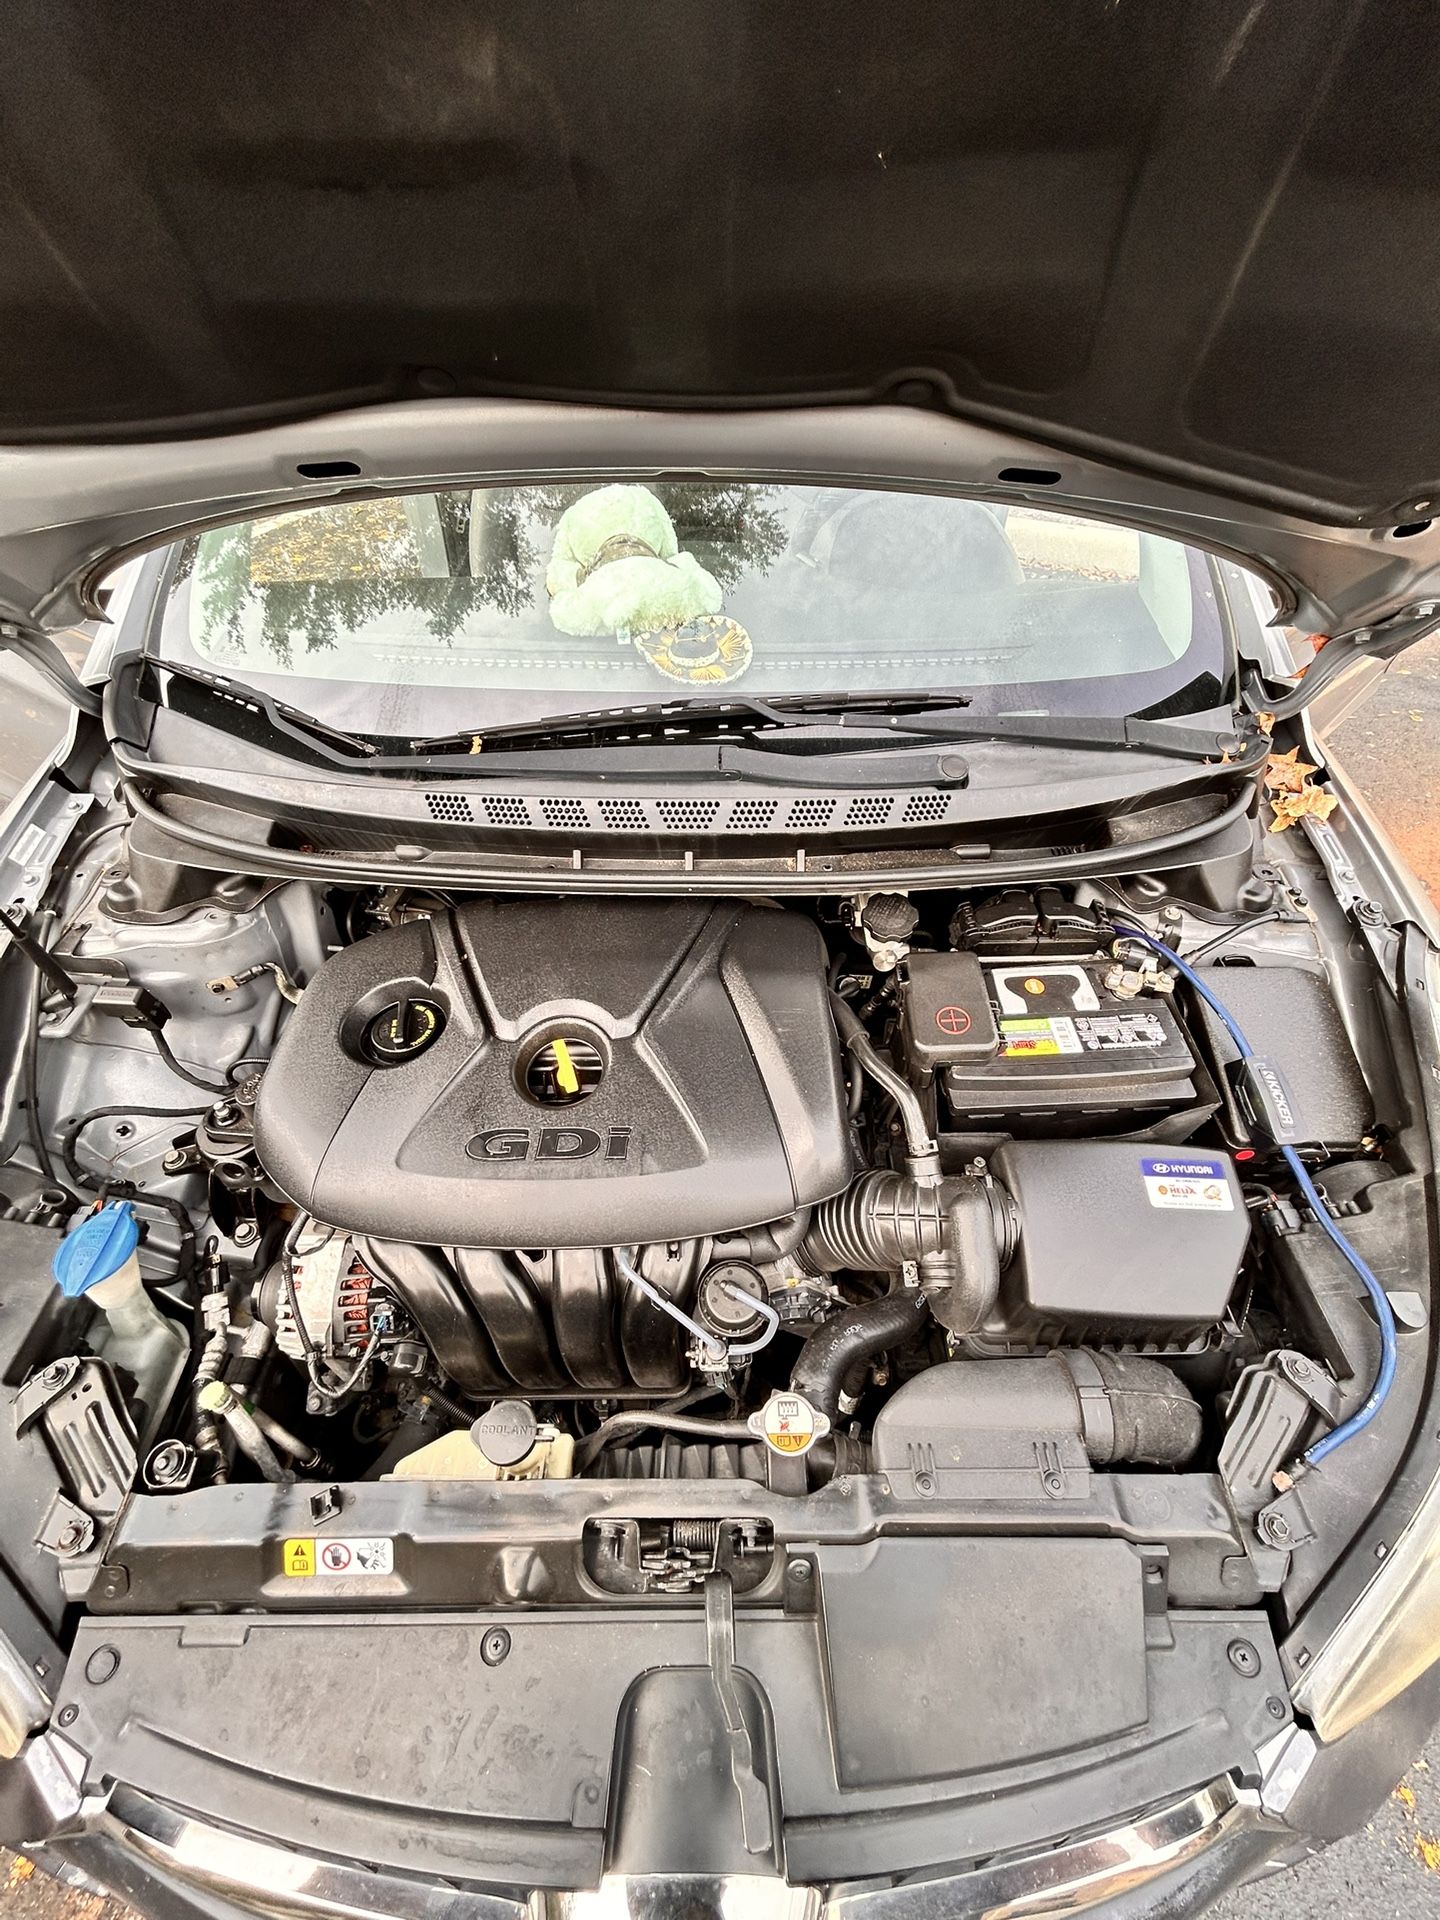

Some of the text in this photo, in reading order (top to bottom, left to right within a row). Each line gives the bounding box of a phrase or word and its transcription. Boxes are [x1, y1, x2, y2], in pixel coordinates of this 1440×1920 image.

[1267, 1080, 1294, 1125] KICKER
[465, 1126, 632, 1160] GDi
[1171, 1164, 1214, 1175] HYUNDAI
[481, 1424, 536, 1436] COOLANT
